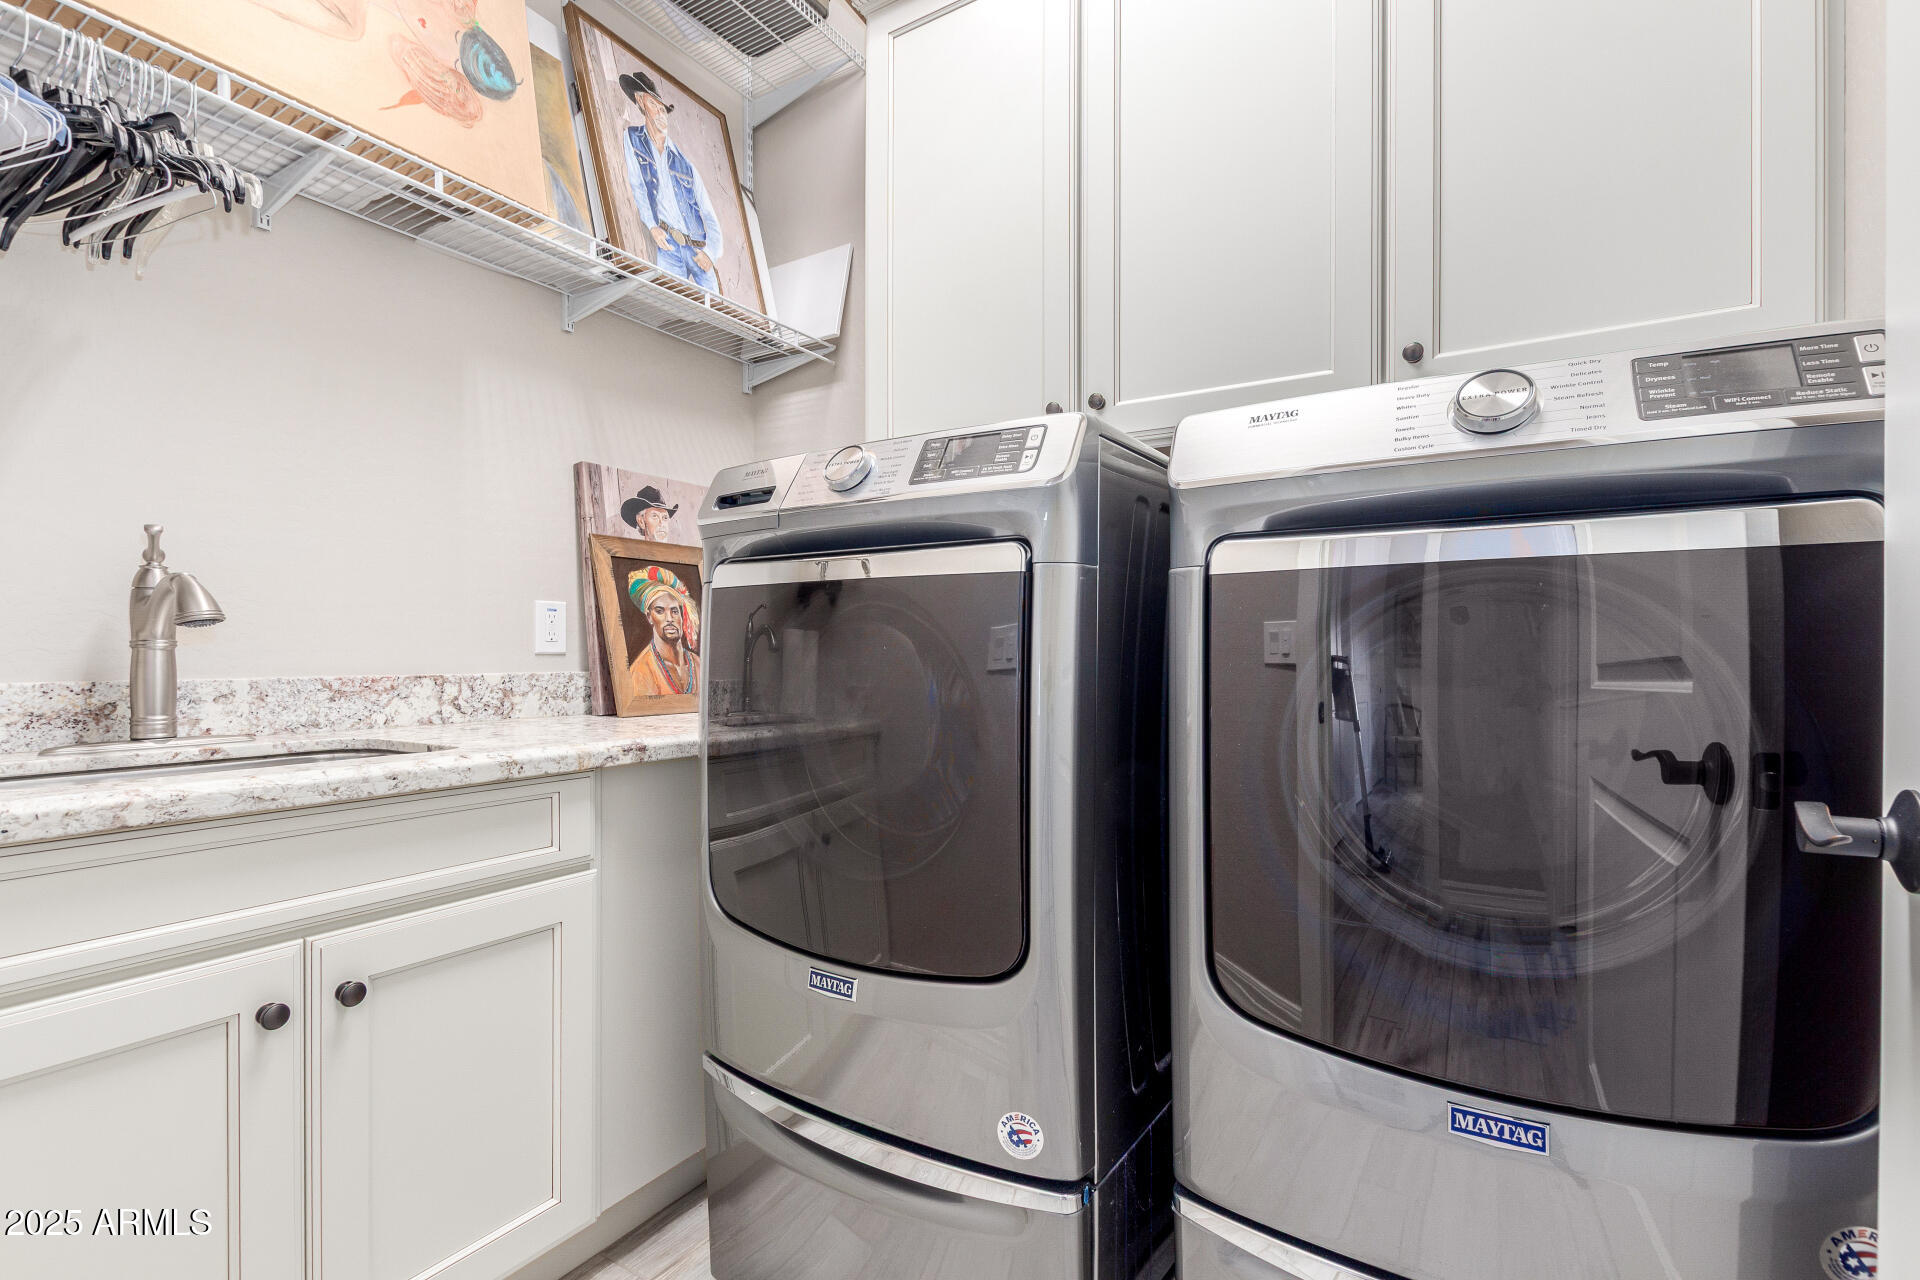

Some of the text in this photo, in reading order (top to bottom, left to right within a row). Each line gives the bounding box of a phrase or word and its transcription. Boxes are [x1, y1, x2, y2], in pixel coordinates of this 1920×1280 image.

[1645, 375, 1677, 383] Dryness
[1494, 387, 1528, 395] POWER
[1648, 387, 1676, 395] Wrinkle
[1649, 392, 1677, 400] Prevent
[1249, 409, 1299, 424] MAYTAG
[810, 973, 852, 996] MAYTAG
[1001, 1113, 1040, 1136] AMERICA
[1453, 1111, 1545, 1149] MAYTAG
[1830, 1229, 1878, 1247] AMER
